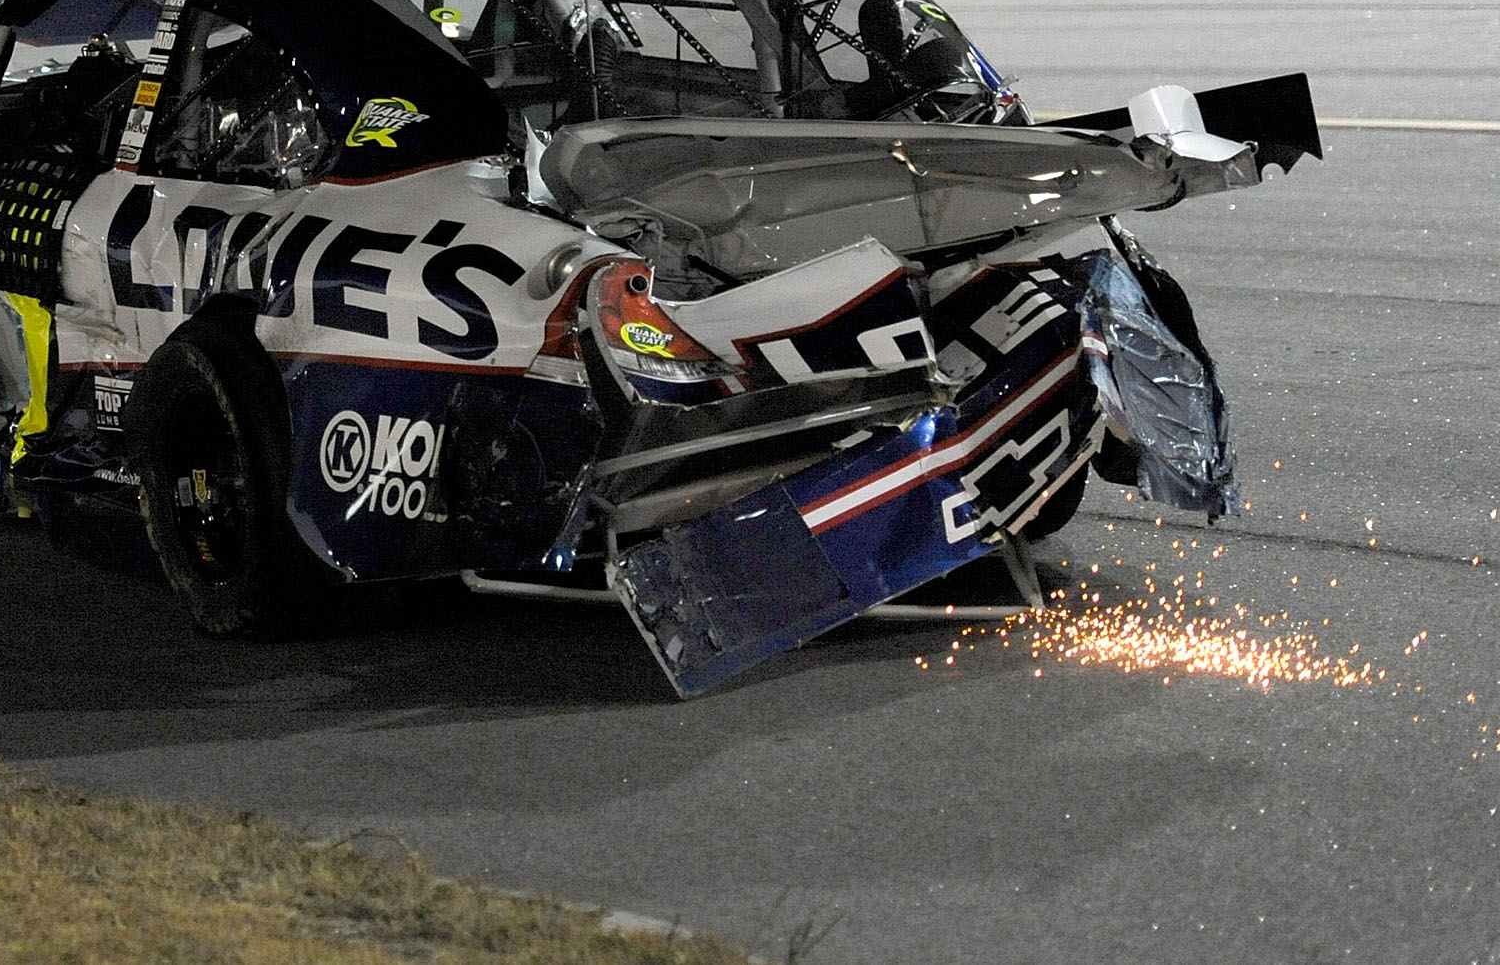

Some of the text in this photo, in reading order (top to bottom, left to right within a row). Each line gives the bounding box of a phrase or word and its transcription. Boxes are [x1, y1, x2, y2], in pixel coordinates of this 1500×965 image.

[361, 103, 430, 123] QUAKER
[360, 116, 412, 130] STATE
[626, 325, 673, 341] QUAKER
[634, 335, 667, 347] STATE
[95, 390, 122, 413] TOP
[97, 414, 120, 426] LUMB
[368, 474, 428, 520] TOO
